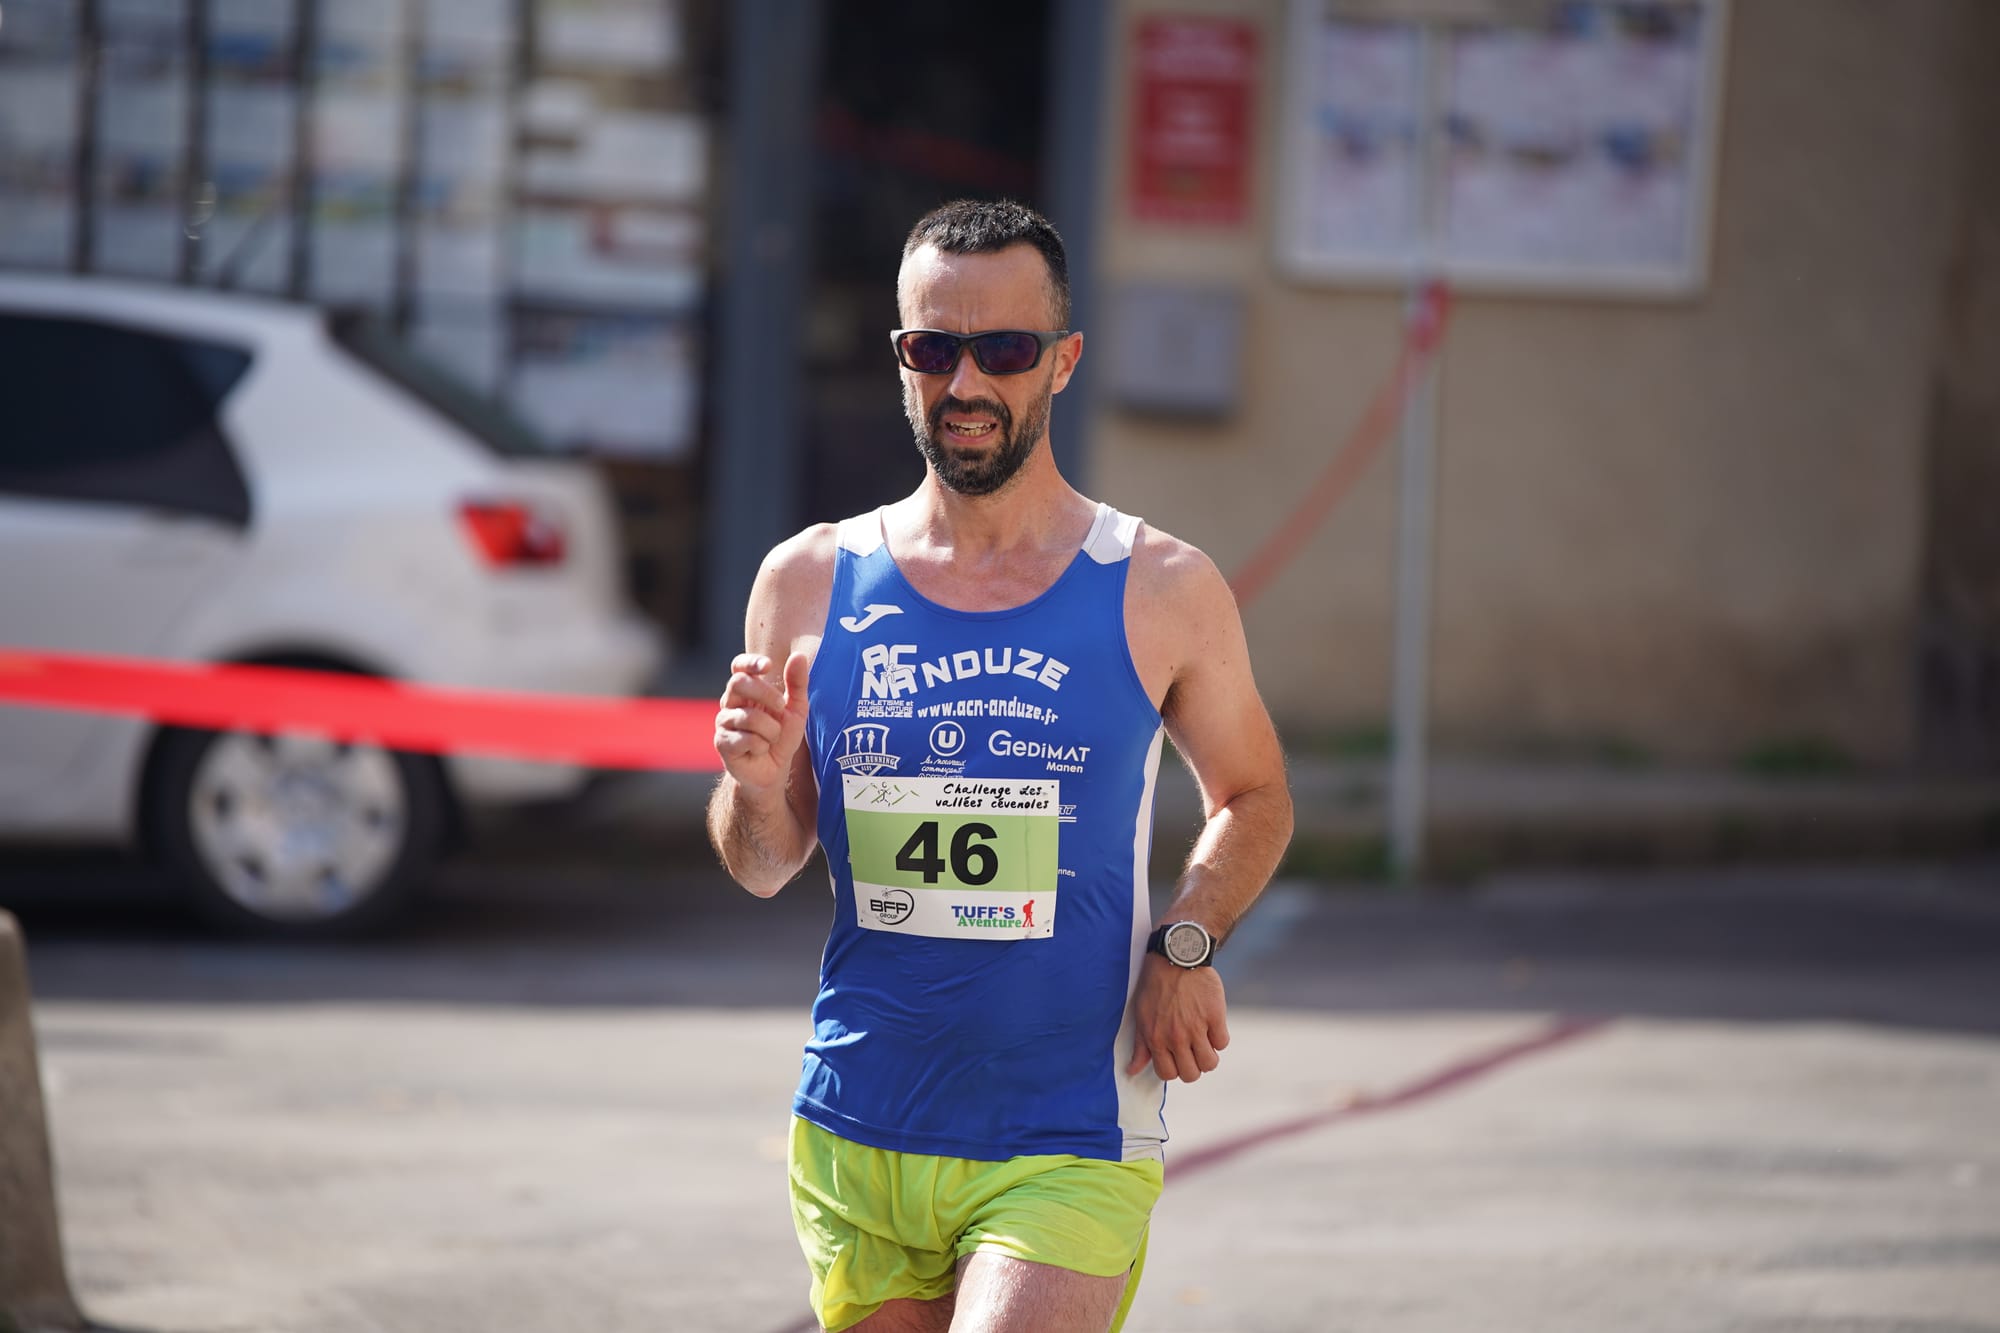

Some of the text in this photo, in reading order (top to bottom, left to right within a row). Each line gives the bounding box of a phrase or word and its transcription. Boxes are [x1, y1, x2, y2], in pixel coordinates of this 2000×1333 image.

[917, 696, 1058, 725] www.acn-anduze.fr
[865, 755, 896, 767] RUNNING
[1046, 761, 1083, 773] Manen
[943, 783, 1011, 799] Challenge
[935, 796, 1049, 809] vallées cévenoles
[895, 821, 998, 885] 46
[870, 899, 908, 914] BFP
[951, 905, 1016, 919] TUFF'S
[957, 916, 1022, 929] Aventure
